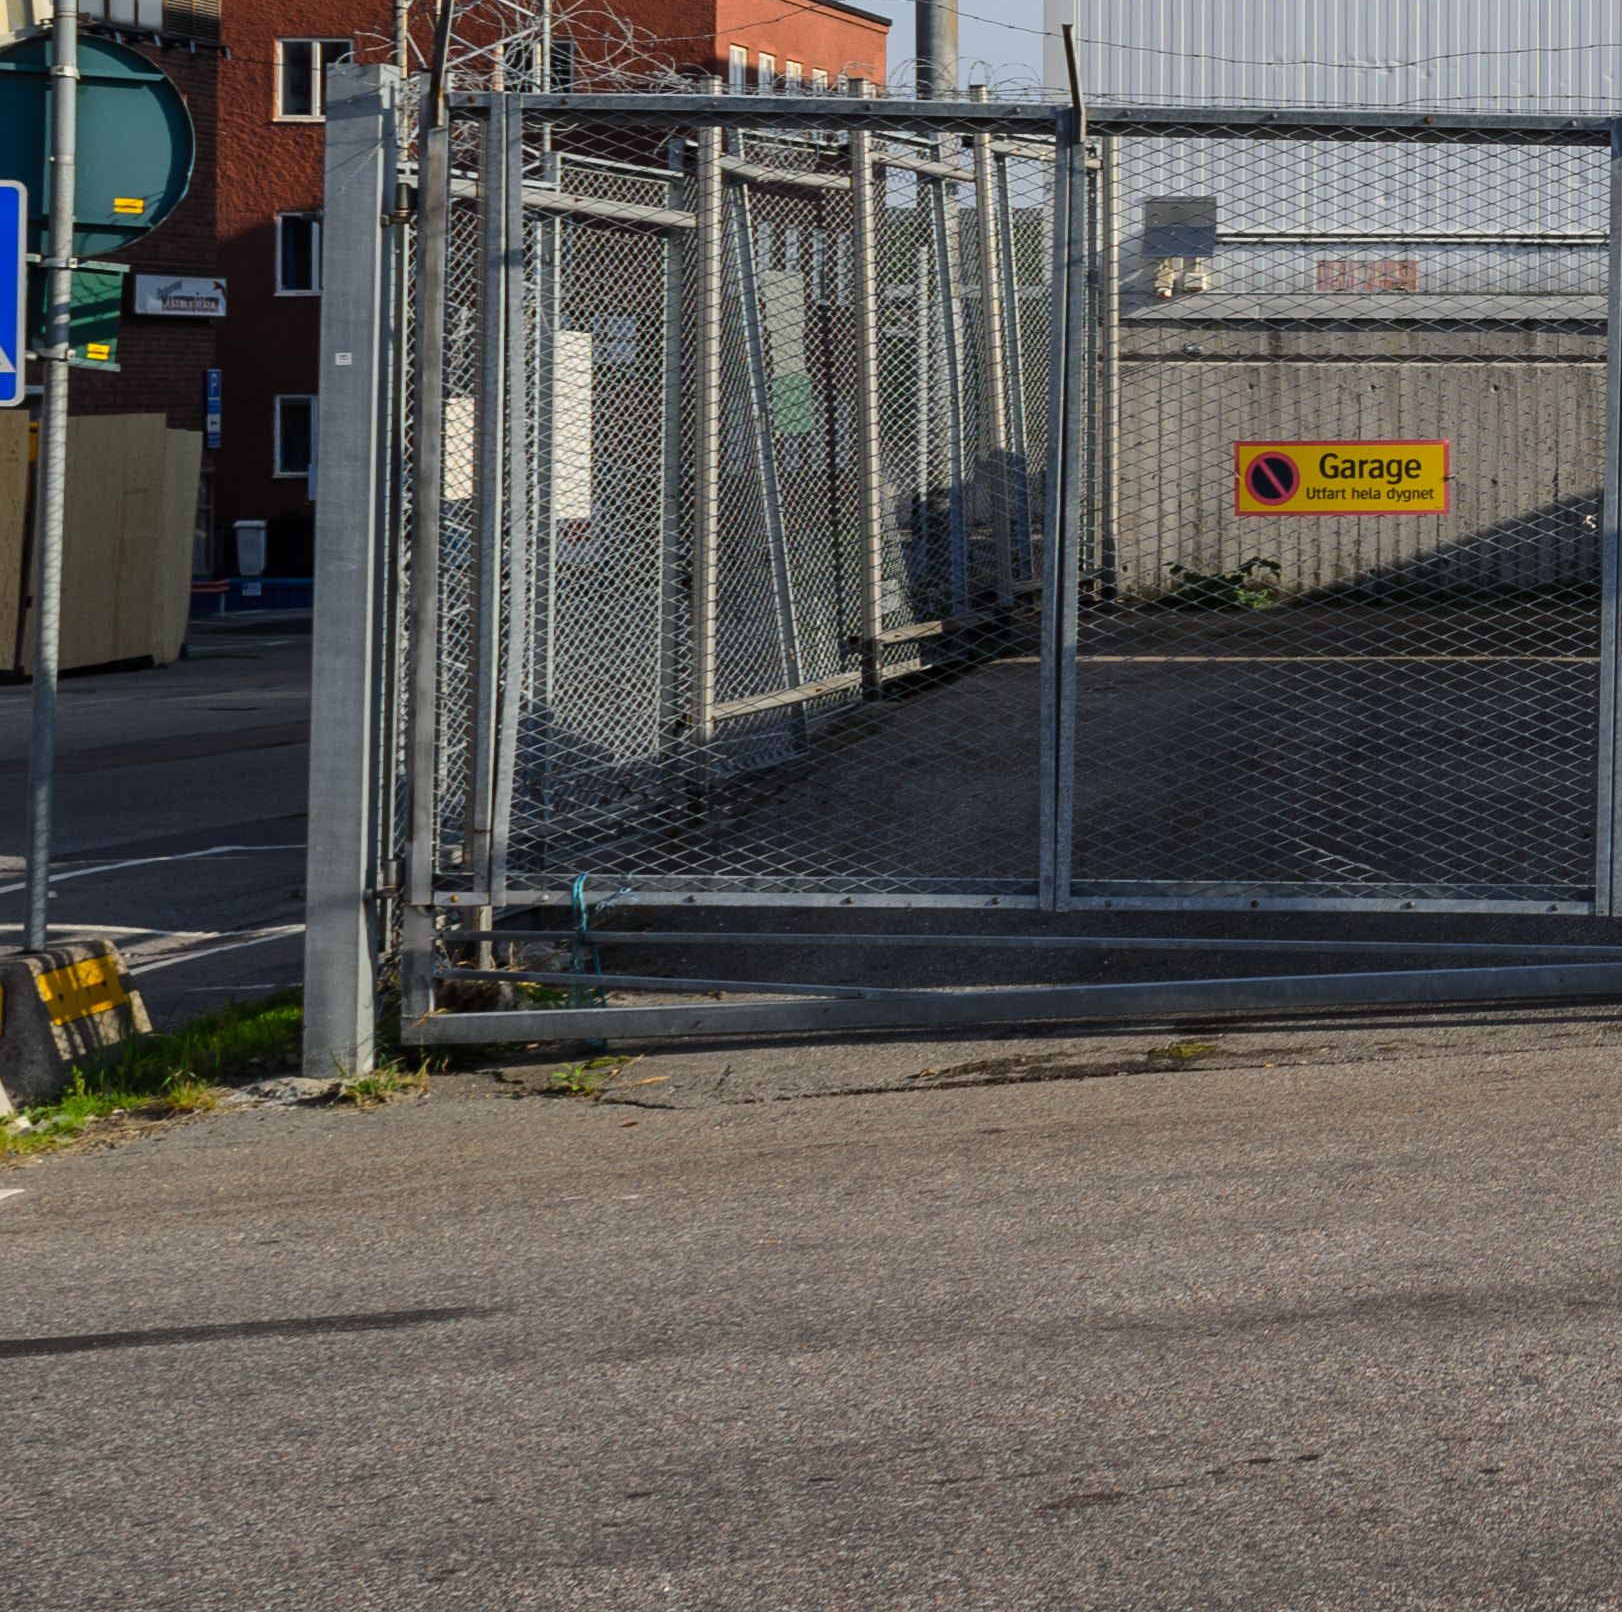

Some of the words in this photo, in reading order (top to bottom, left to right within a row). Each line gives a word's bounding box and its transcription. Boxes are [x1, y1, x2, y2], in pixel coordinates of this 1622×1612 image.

[1319, 452, 1422, 485] Garage
[1306, 487, 1347, 500] Utfart
[1351, 487, 1381, 500] hela
[1386, 487, 1435, 502] dygnet
